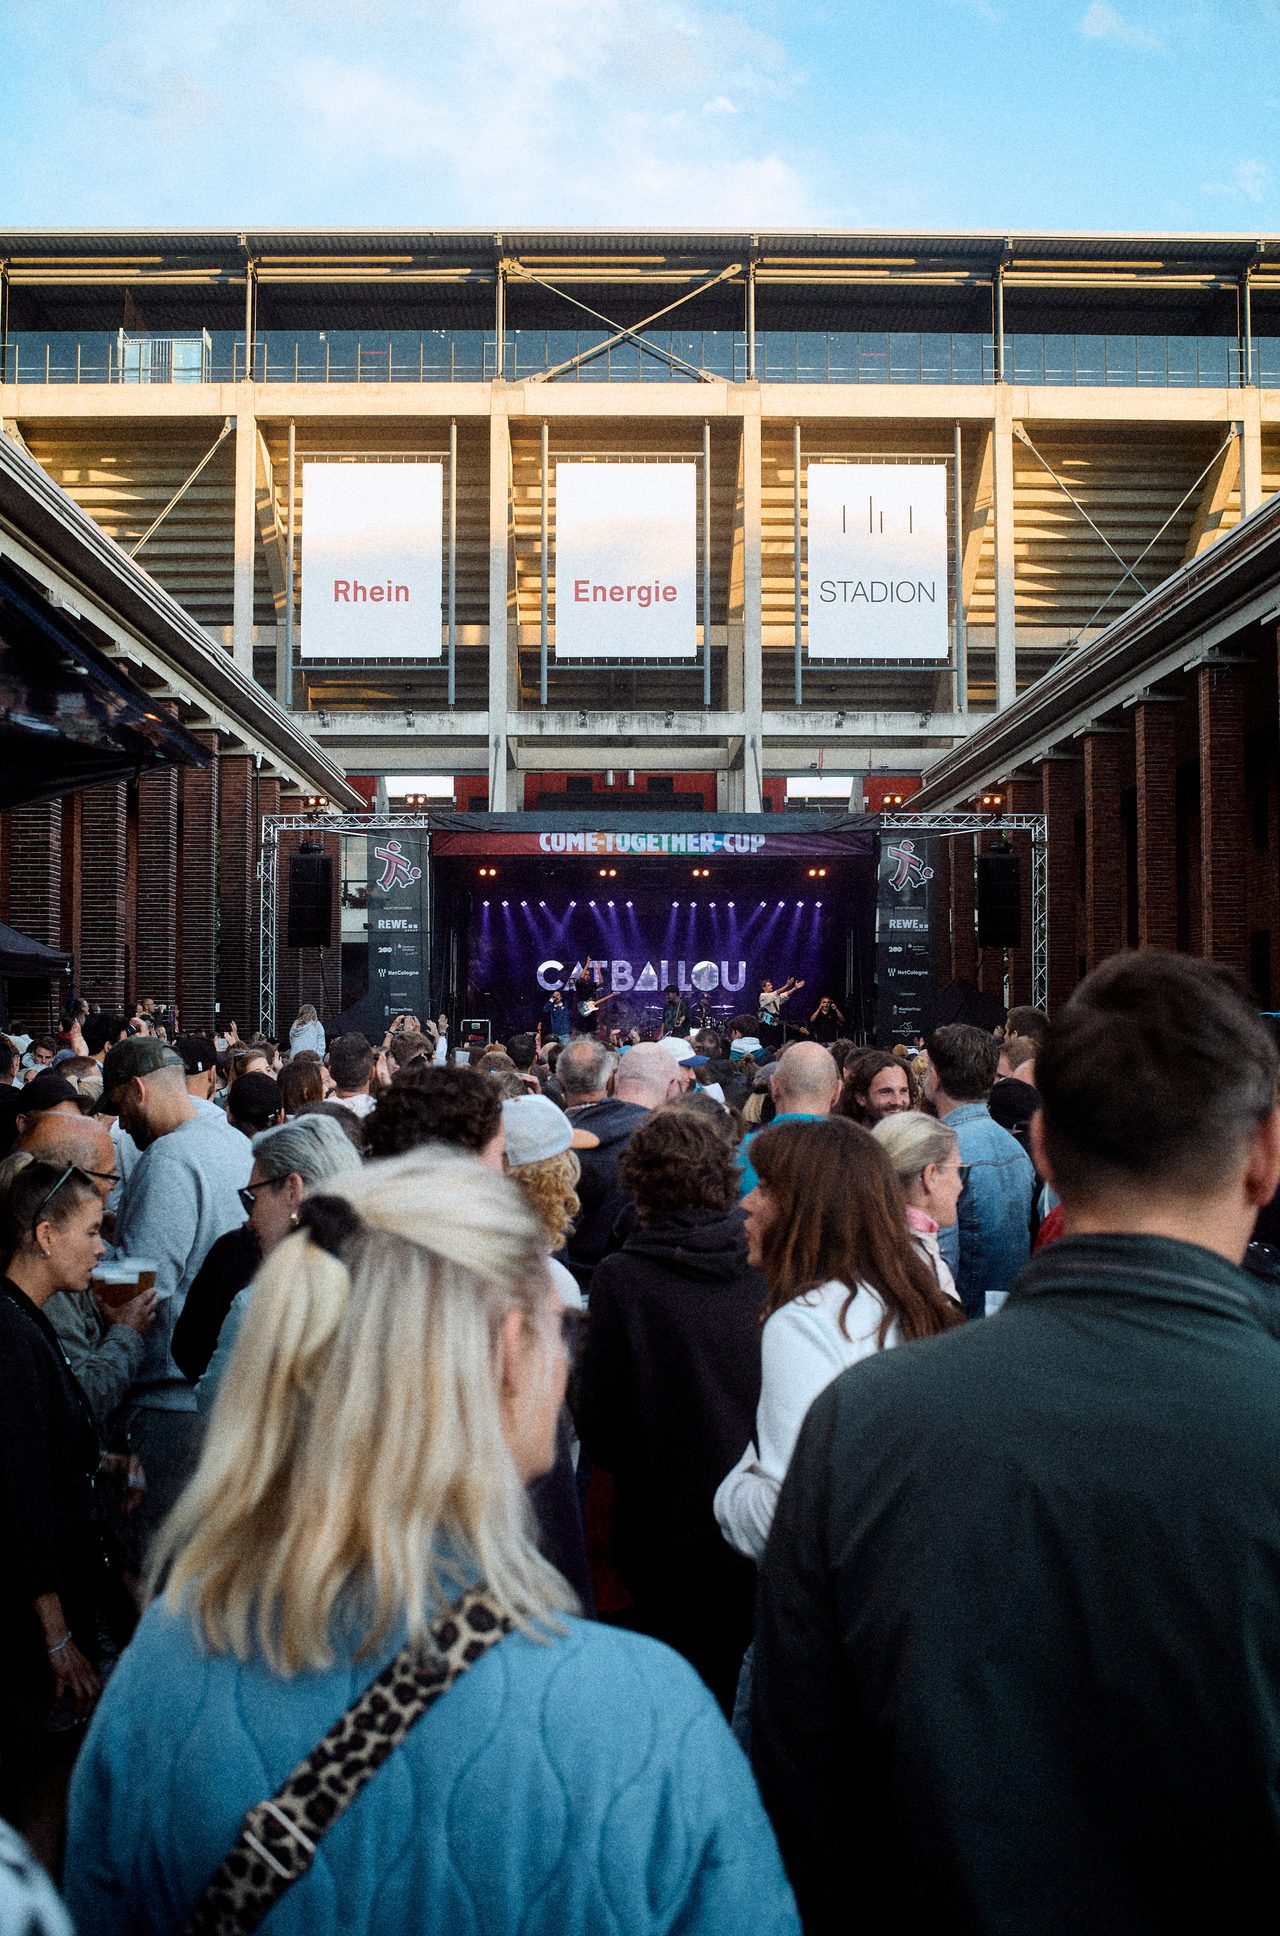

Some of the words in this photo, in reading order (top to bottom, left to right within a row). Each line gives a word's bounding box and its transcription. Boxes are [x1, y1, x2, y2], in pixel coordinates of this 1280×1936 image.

[334, 580, 410, 602] Rhein
[574, 580, 678, 608] Energie
[820, 580, 935, 603] STADION
[539, 832, 766, 853] COME-TOGETHER-CUP
[378, 920, 408, 929] REWE
[889, 919, 919, 928] REWE
